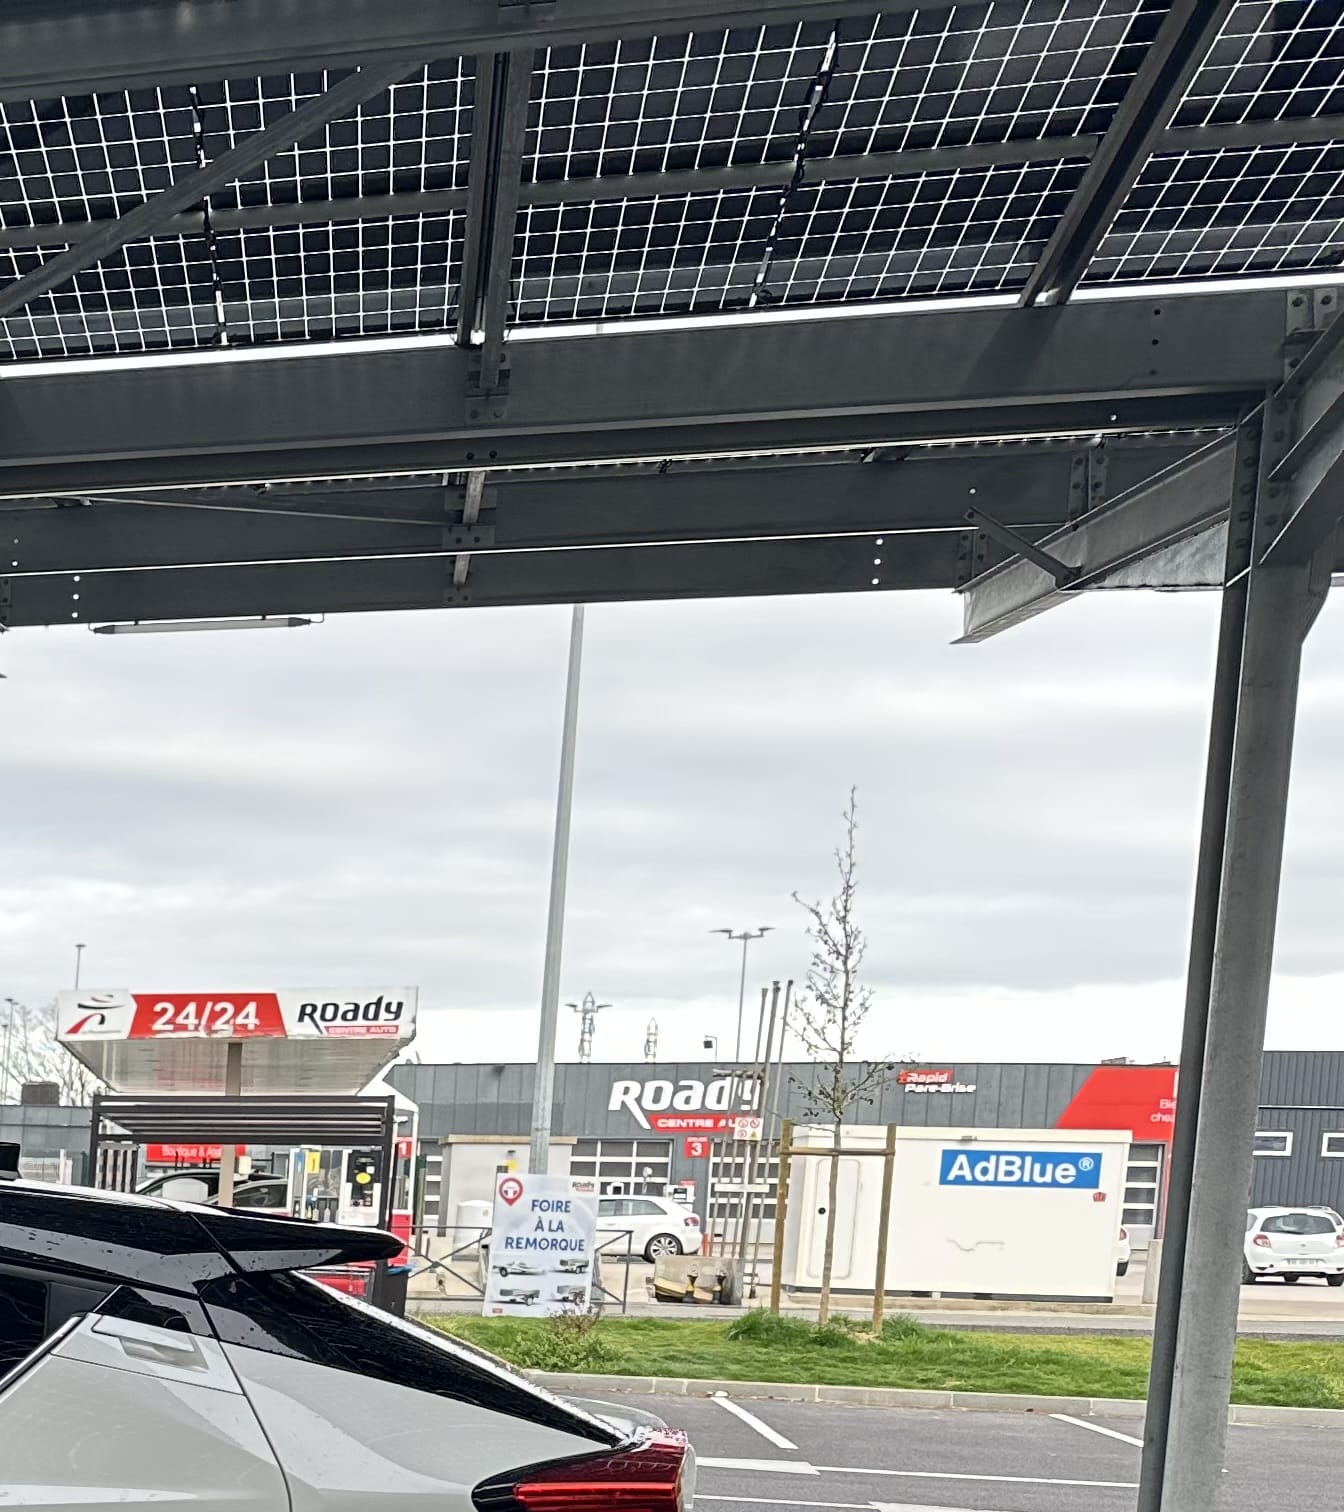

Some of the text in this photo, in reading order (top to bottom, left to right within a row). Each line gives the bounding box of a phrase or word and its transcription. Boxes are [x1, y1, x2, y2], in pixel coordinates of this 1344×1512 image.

[152, 1001, 260, 1031] 24/24
[297, 995, 404, 1035] Roady
[906, 1072, 949, 1084] Rapid
[657, 1118, 714, 1128] CENTRE
[690, 1142, 703, 1156] 3
[531, 1200, 571, 1213] FOIRE
[534, 1216, 564, 1233] À LA
[504, 1237, 584, 1252] REMORQUE
